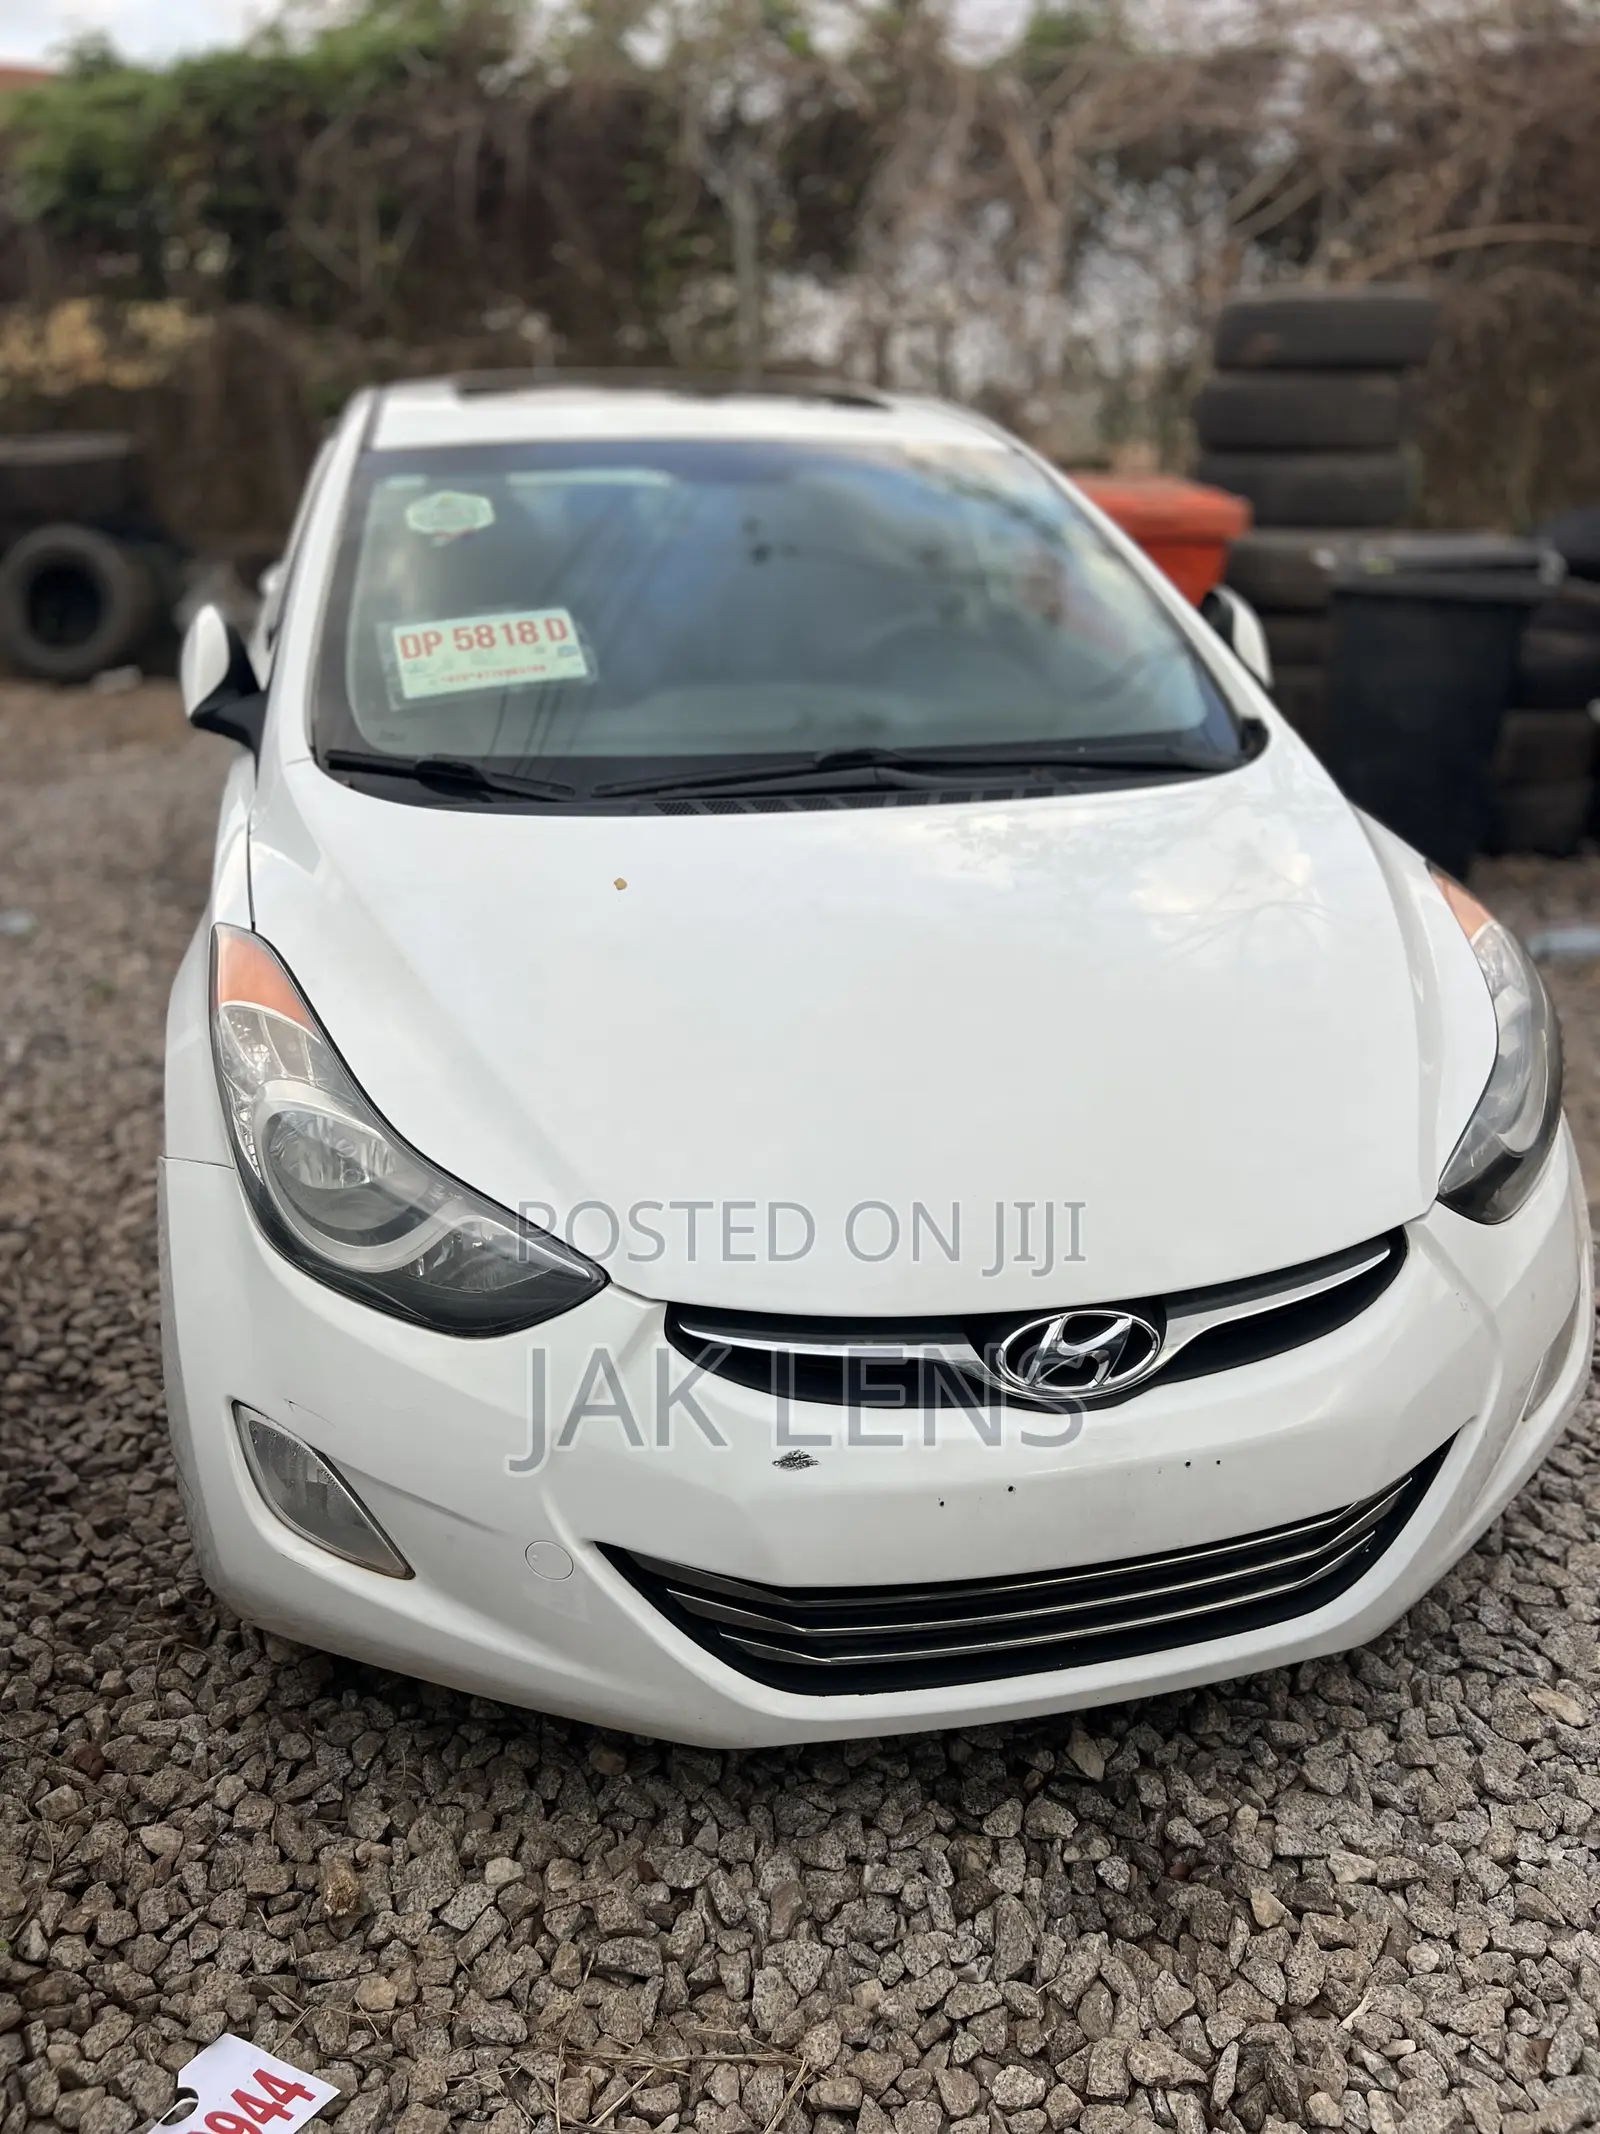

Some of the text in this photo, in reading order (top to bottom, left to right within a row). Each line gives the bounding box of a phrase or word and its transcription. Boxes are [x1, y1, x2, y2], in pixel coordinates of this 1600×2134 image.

[400, 631, 442, 660] DP
[452, 620, 540, 651] 5818
[186, 2068, 317, 2134] 944
